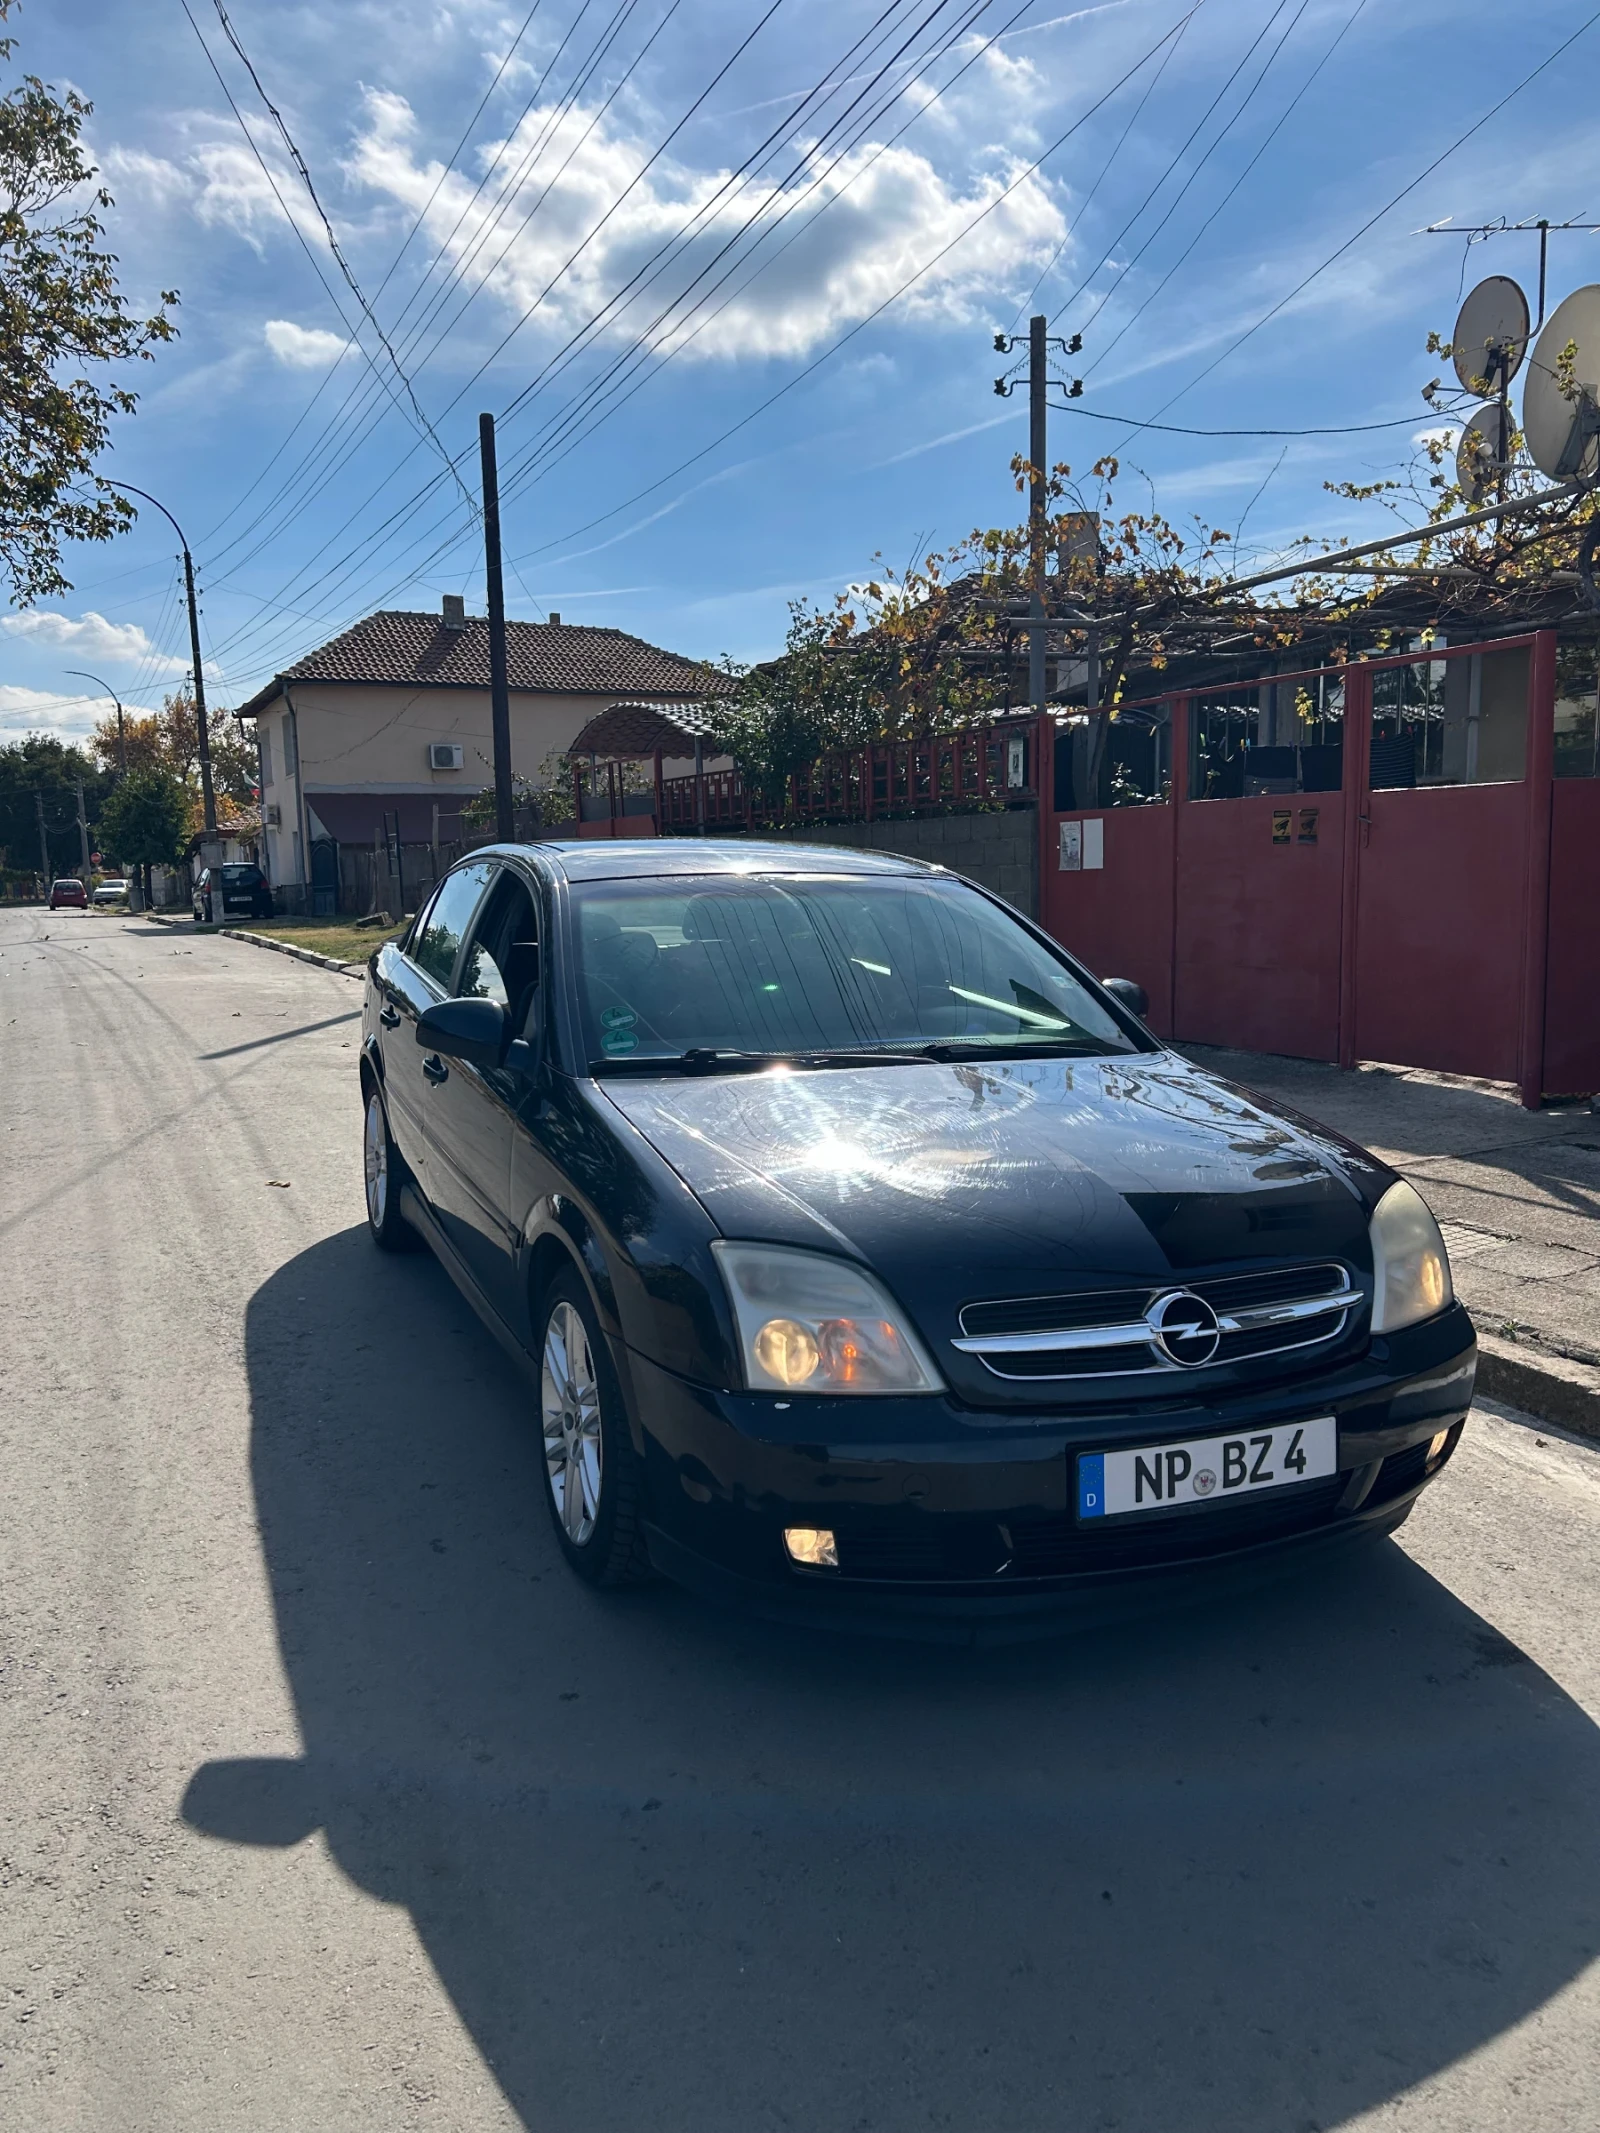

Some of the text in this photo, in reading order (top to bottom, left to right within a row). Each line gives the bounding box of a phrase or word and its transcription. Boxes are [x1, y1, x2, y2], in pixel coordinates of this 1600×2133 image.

[1135, 1449, 1191, 1503] NP
[1222, 1434, 1274, 1489] BZ
[1284, 1429, 1307, 1475] 4
[1086, 1493, 1097, 1507] D
